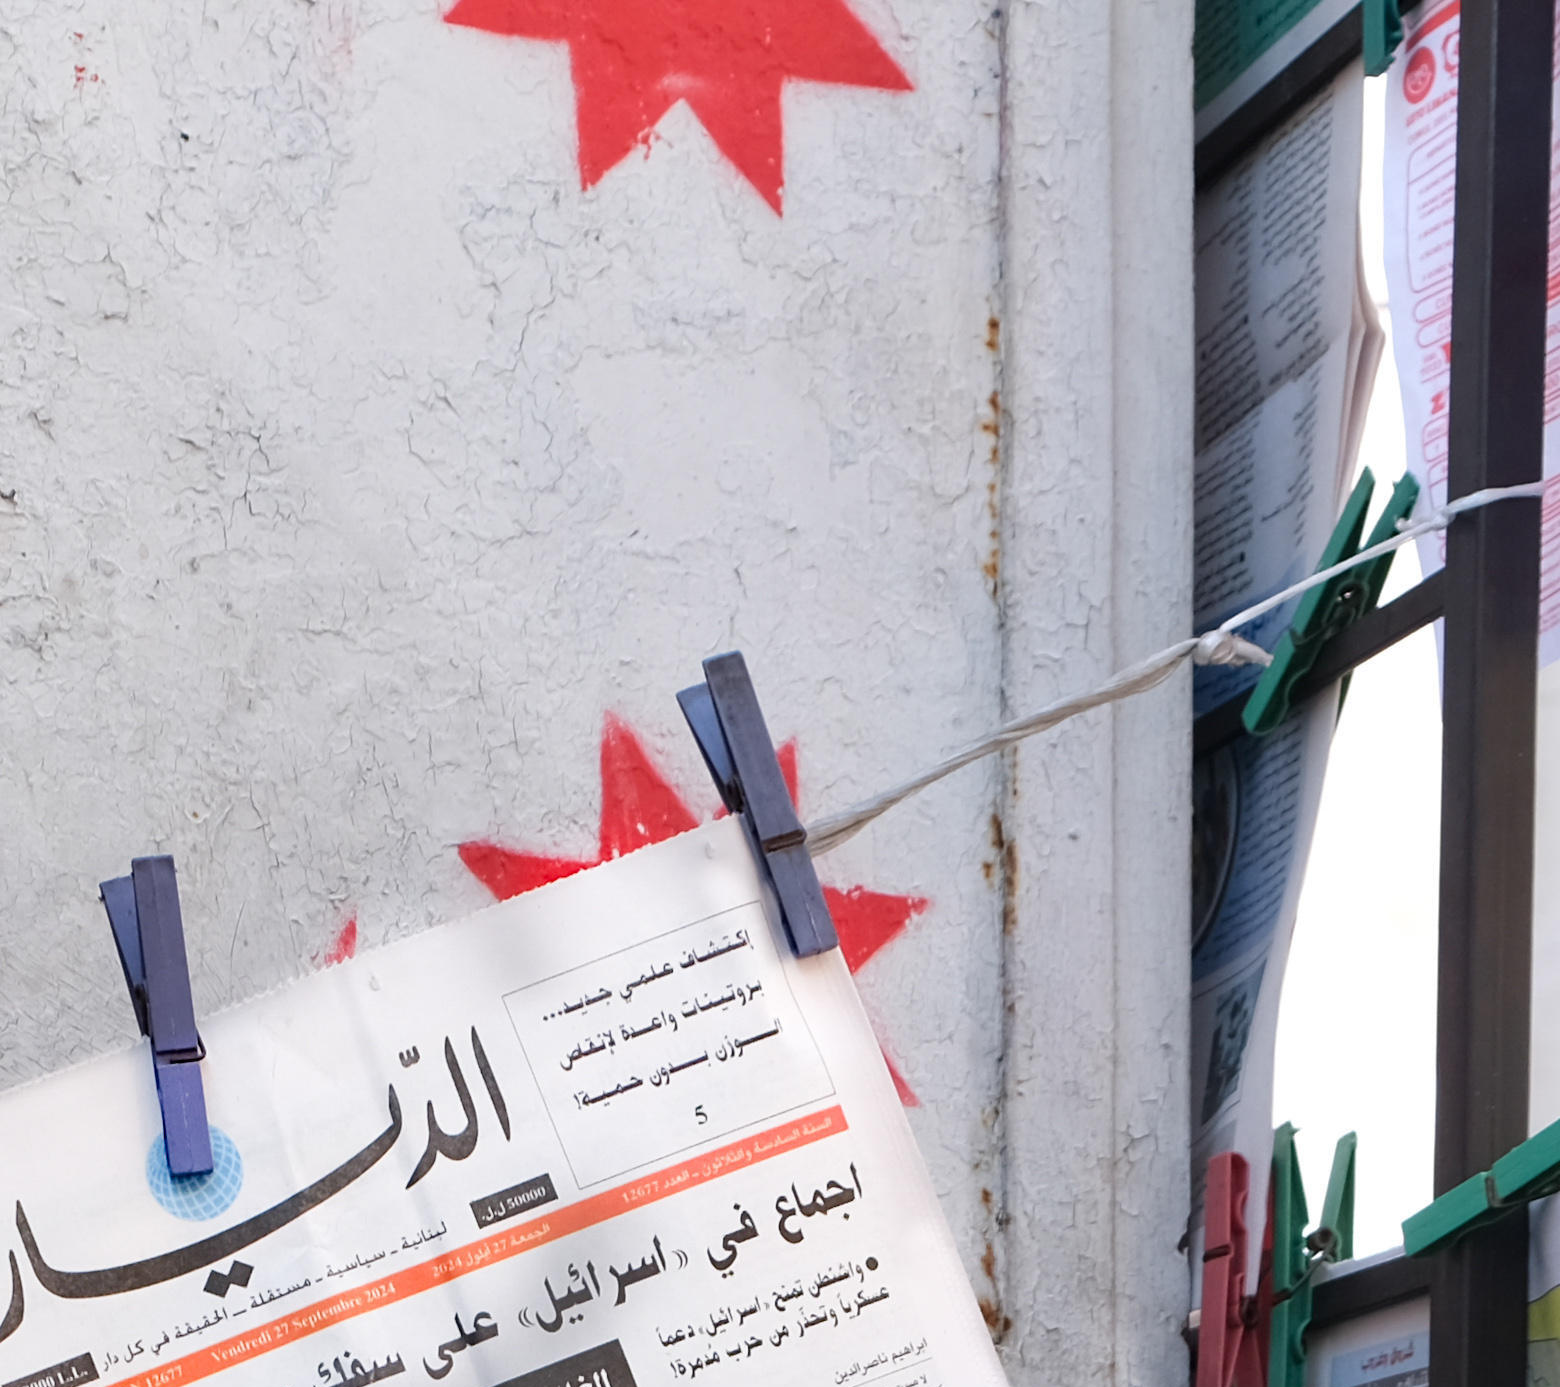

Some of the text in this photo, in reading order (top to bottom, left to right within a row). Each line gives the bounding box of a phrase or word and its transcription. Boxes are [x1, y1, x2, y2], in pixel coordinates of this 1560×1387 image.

[619, 1010, 678, 1042] واعدة
[715, 1020, 780, 1062] الوزن
[649, 1050, 709, 1088] بدون
[694, 1104, 708, 1125] 5
[774, 1161, 862, 1245] اجماع
[706, 1202, 759, 1279] في
[210, 1281, 396, 1361] Vendredi 27 Septembre 2024
[422, 1310, 499, 1380] على
